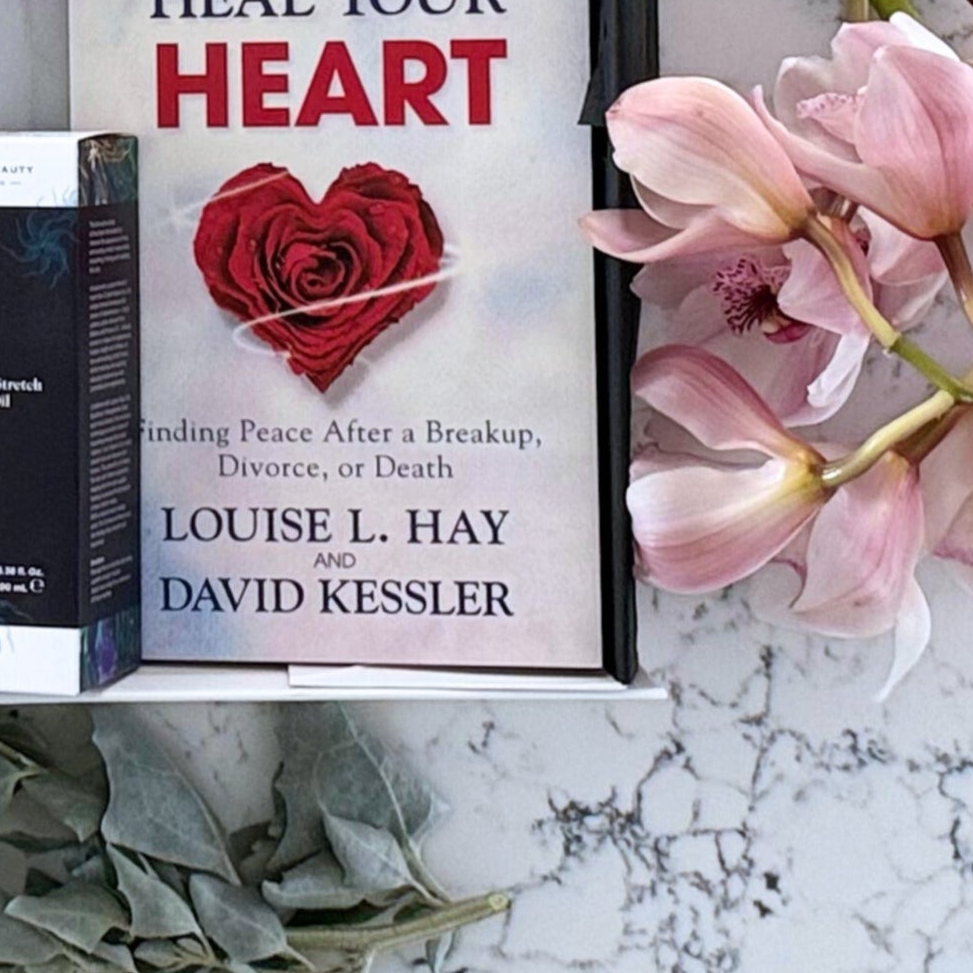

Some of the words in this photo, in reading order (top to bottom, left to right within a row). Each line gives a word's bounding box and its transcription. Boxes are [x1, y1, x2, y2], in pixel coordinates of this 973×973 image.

[156, 38, 508, 128] HEART
[240, 419, 313, 443] Peace
[323, 420, 391, 443] After
[402, 429, 415, 444] a
[426, 420, 542, 450] Breakup,
[218, 454, 328, 481] Divorce,
[337, 462, 365, 479] or
[374, 454, 453, 479] Death
[160, 507, 332, 543] LOUISE
[348, 509, 388, 543] L.
[406, 510, 510, 546] HAY
[313, 552, 356, 569] AND
[159, 576, 305, 614] DAVID
[319, 578, 514, 616] KESSLER
